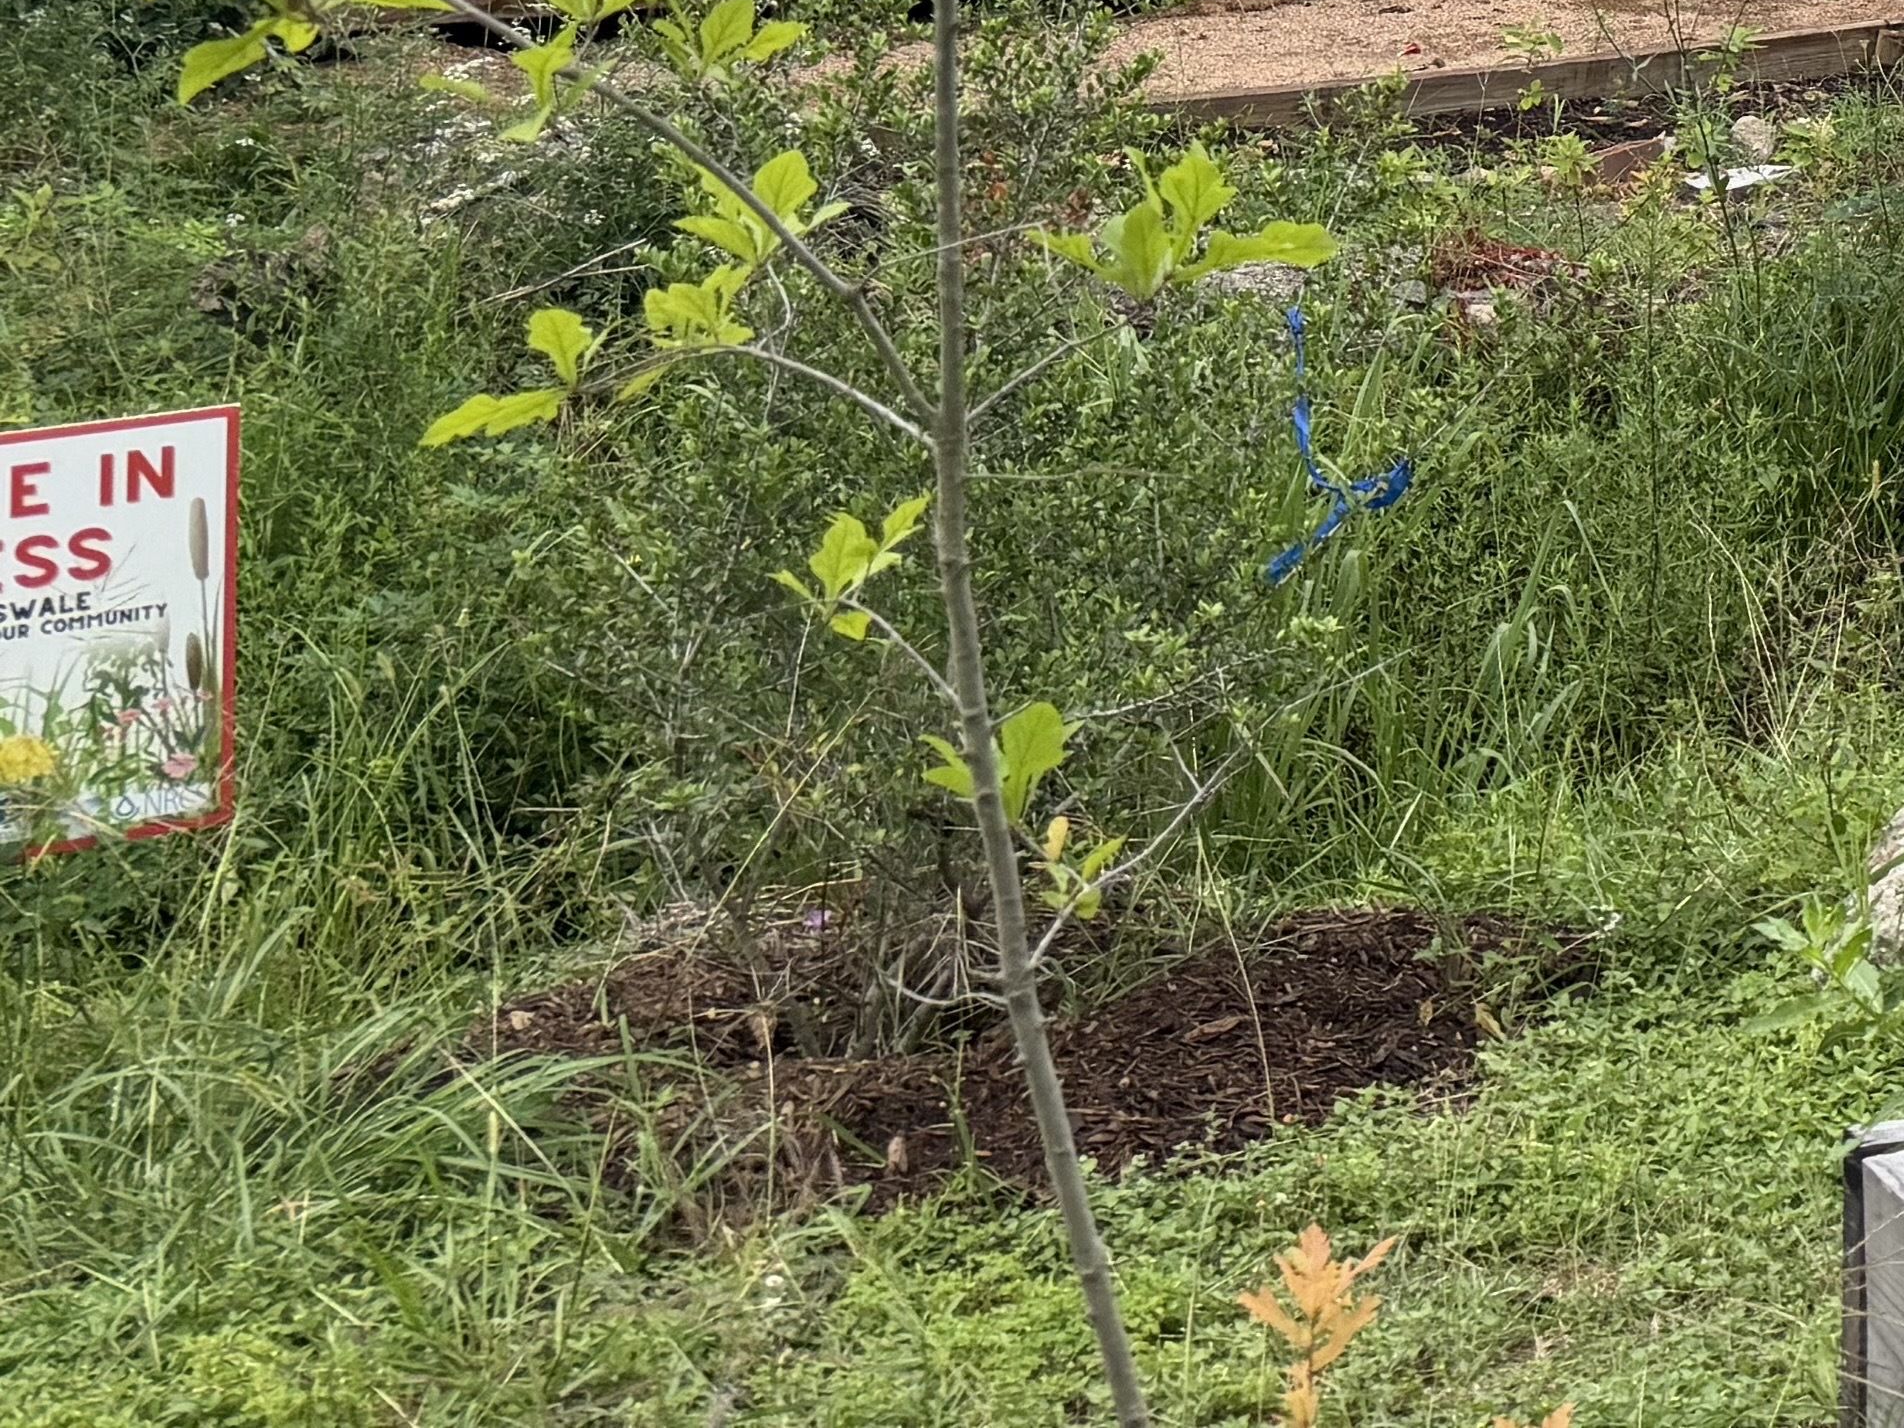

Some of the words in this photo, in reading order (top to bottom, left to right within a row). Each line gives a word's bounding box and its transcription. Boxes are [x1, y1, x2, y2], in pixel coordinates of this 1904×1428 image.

[99, 445, 176, 507] IN
[0, 527, 113, 591] SS
[0, 624, 30, 641] UR
[40, 602, 168, 635] COMMUNITY
